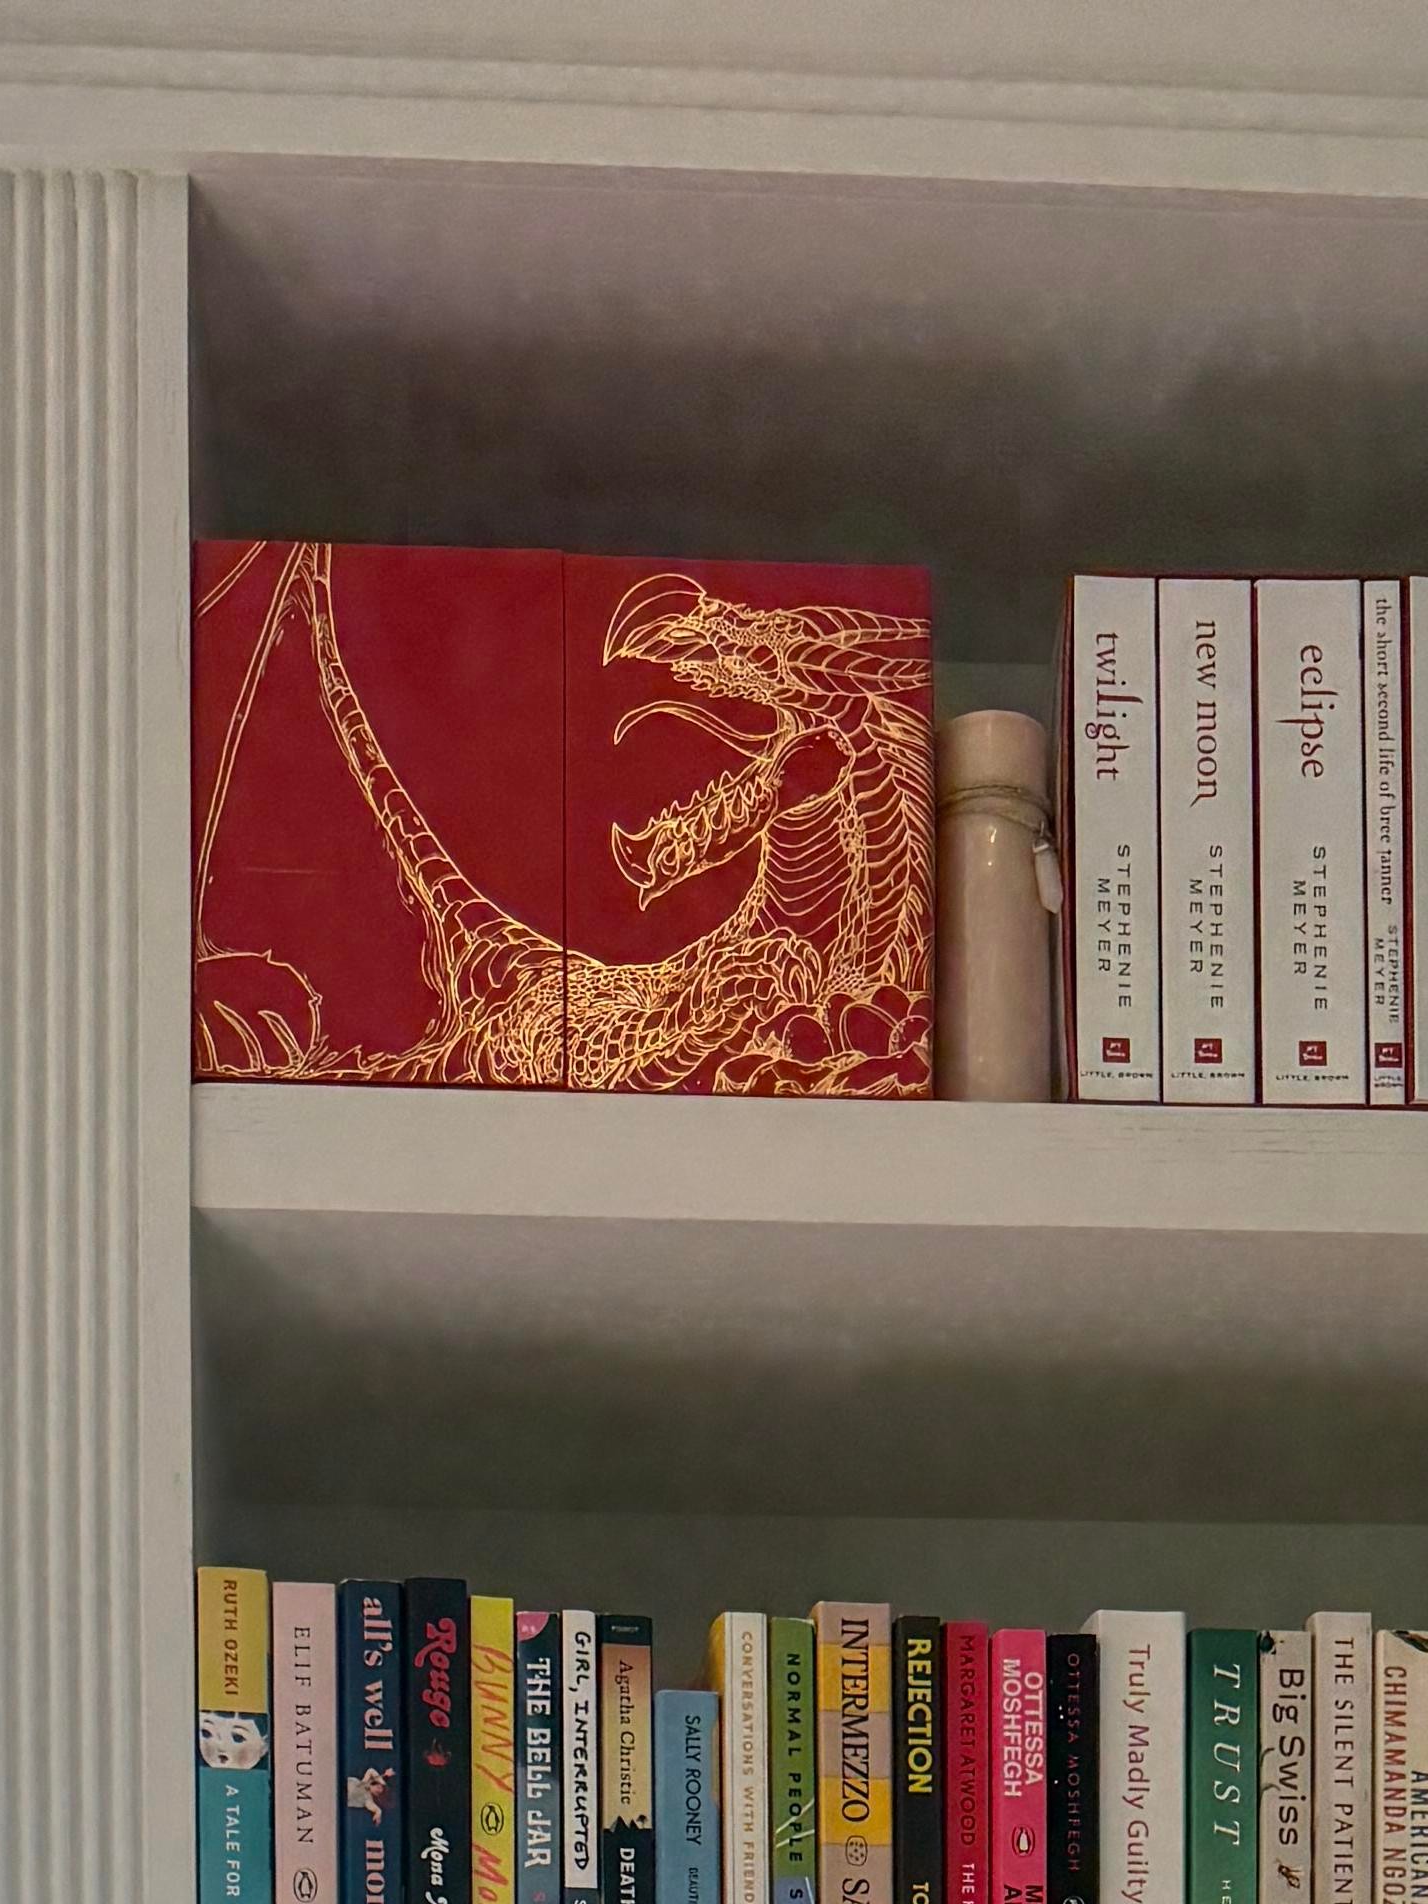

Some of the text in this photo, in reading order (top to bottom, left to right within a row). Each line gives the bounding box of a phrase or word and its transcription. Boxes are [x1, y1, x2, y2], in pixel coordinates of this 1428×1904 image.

[1087, 632, 1144, 781] twilight
[1189, 620, 1220, 808] new moon
[1274, 644, 1339, 778] eclipse
[1097, 877, 1111, 973] MEYER
[1117, 844, 1132, 1009] STEPHENIE
[294, 1626, 311, 1688] ELIF
[364, 1681, 393, 1749] well
[570, 1631, 591, 1693] GIRL,
[616, 1660, 635, 1725] Agatha
[908, 1639, 933, 1794] REJECTION
[1274, 1667, 1306, 1724] Big
[295, 1704, 313, 1845] BATUMAN
[573, 1700, 591, 1871] INTERRUPTED
[619, 1731, 636, 1804] Christie
[1122, 1644, 1151, 1904] Truly Madly Guilty
[1279, 1735, 1304, 1847] Swiss
